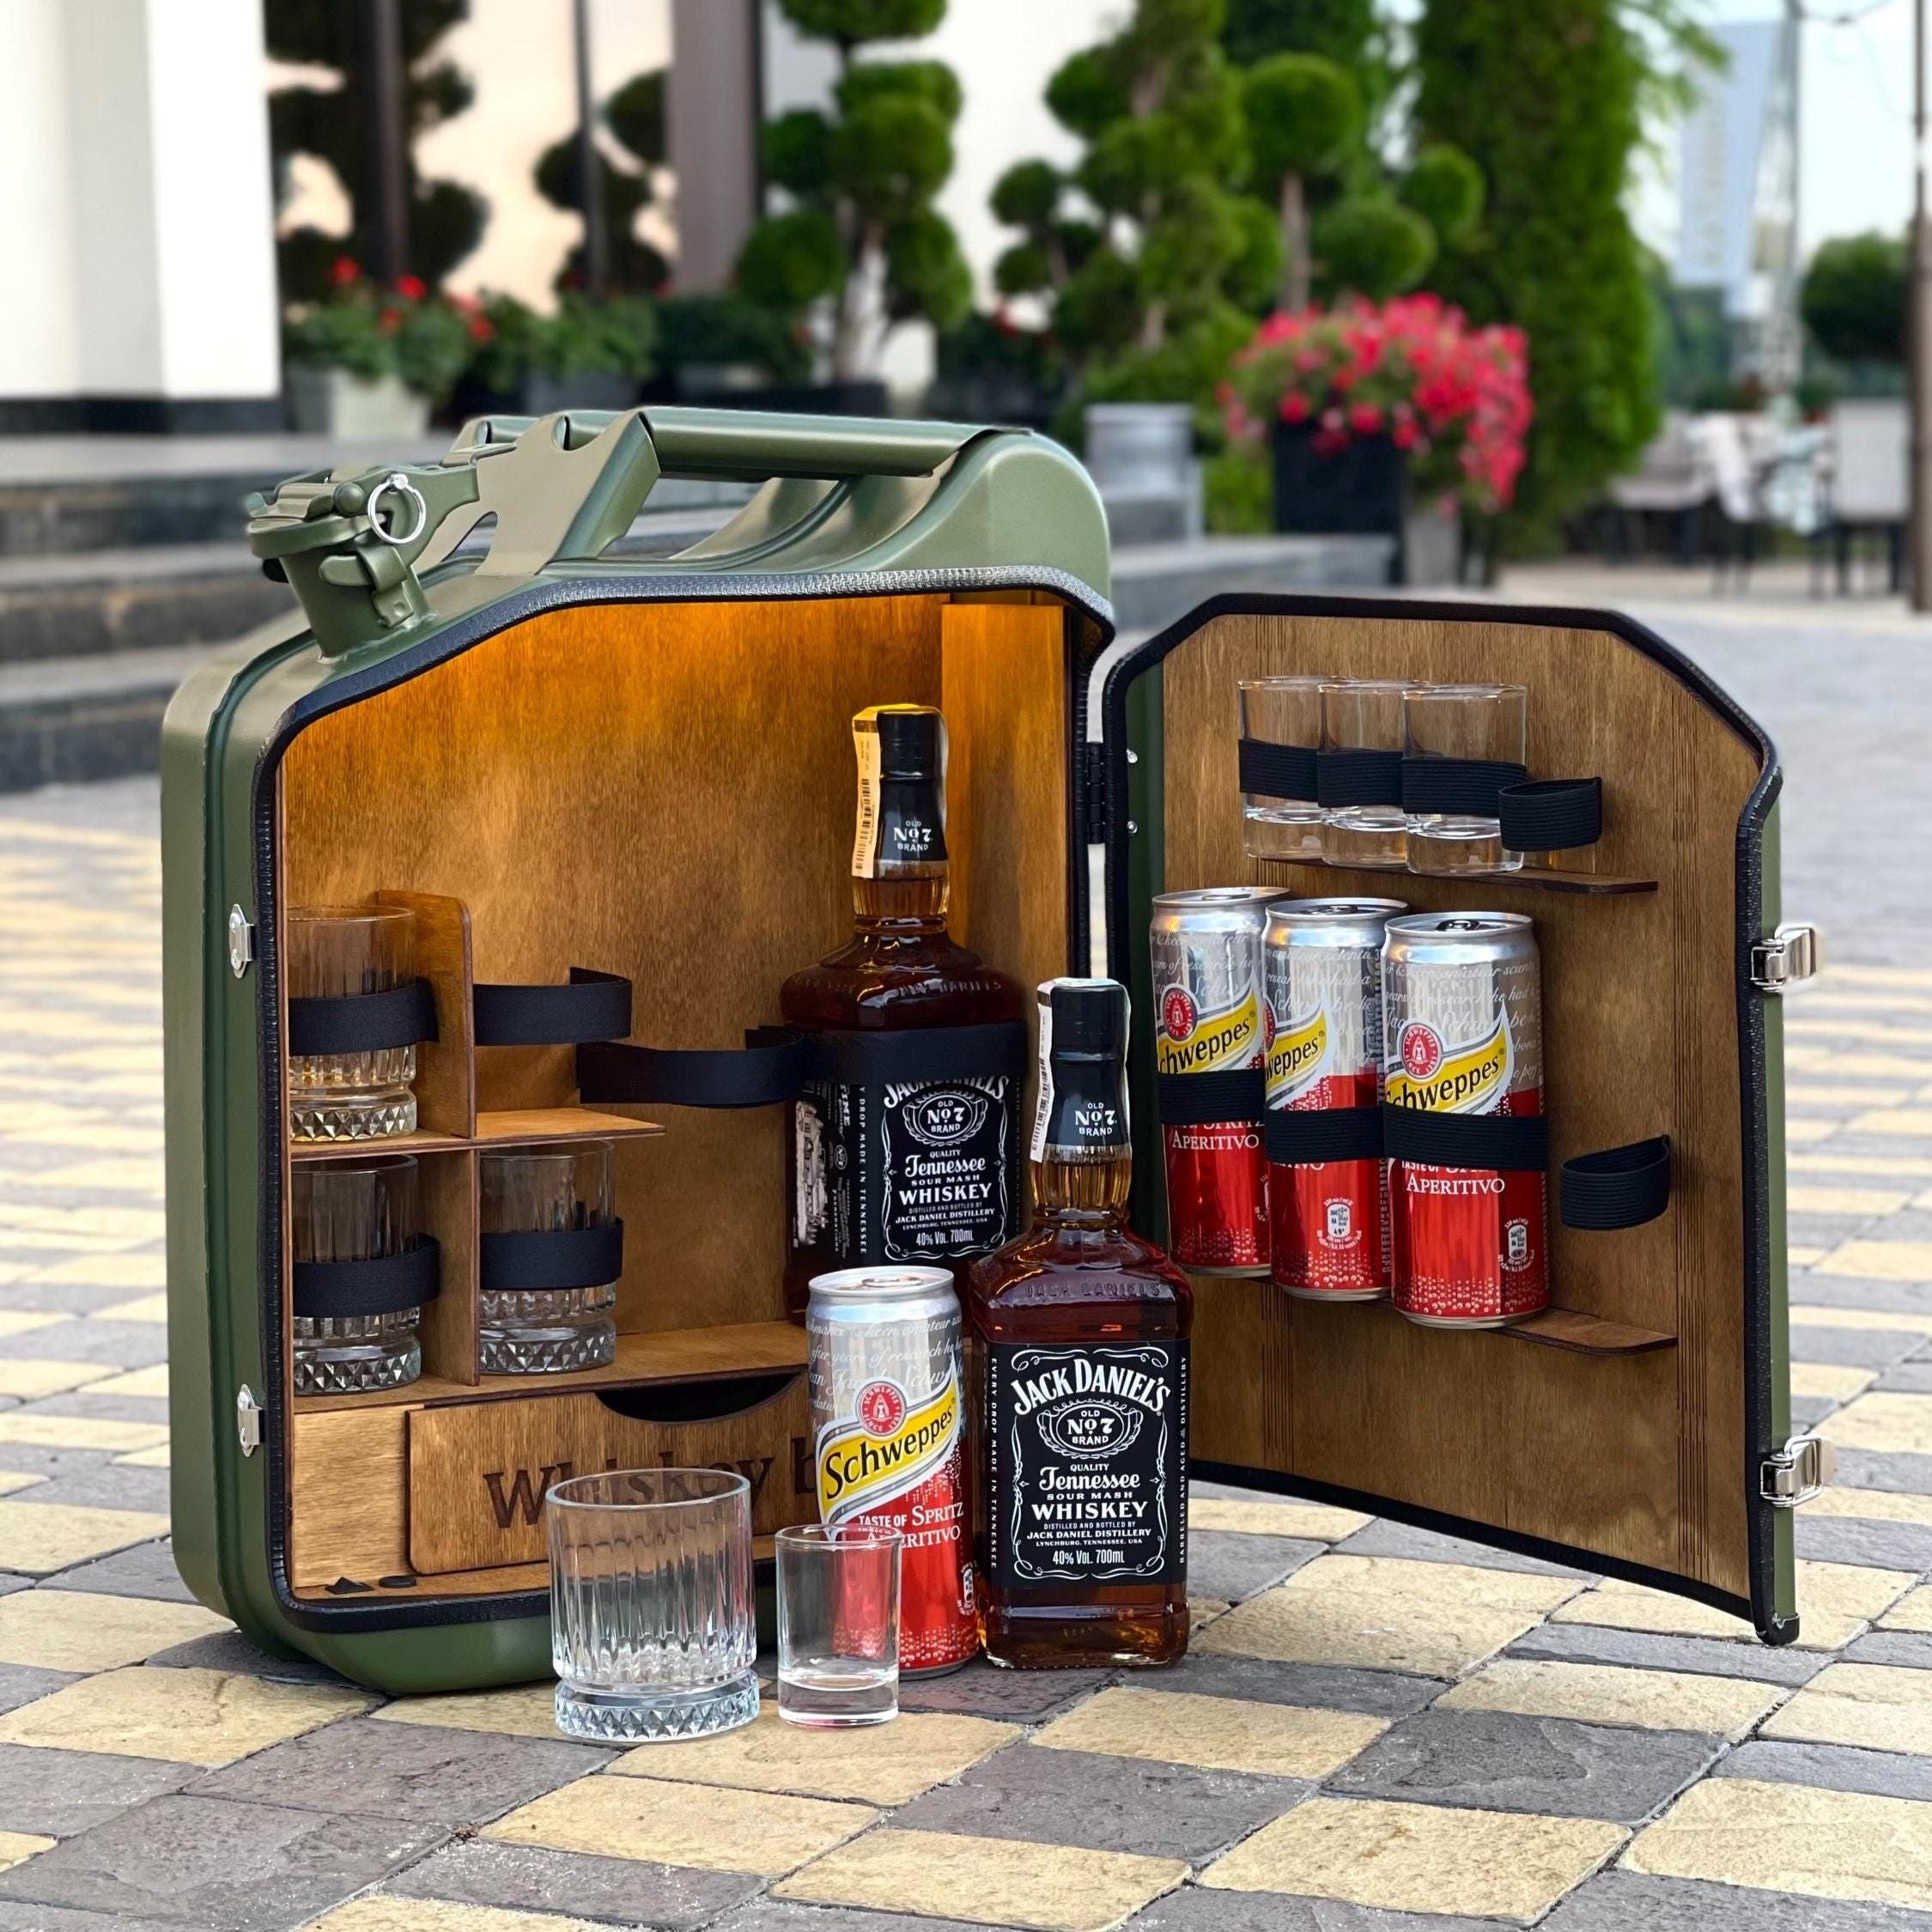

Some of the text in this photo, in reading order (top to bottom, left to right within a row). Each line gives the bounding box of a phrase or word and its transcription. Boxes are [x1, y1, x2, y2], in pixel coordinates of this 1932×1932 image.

[897, 842, 928, 852] BRAND
[938, 1099, 954, 1108] OLD
[931, 1123, 961, 1133] BRAND
[1078, 1127, 1113, 1137] BRAND
[1172, 1129, 1260, 1151] APERITIVO
[929, 1149, 962, 1159] QUALITY
[905, 1154, 987, 1177] Tennessee
[860, 1170, 866, 1182] IN
[911, 1174, 981, 1187] SOUR MASH
[1406, 1172, 1506, 1195] APERITIVO
[898, 1182, 993, 1206] WHISKEY
[895, 1207, 996, 1224] JACK DANIEL DISTILLERY
[908, 1204, 937, 1214] DISTILLED
[915, 1232, 934, 1246] 40%
[1011, 1358, 1171, 1416] JACK DANIEL'S
[1081, 1409, 1100, 1418] OLD
[1072, 1435, 1109, 1446] BRAND
[824, 1407, 953, 1499] Schweppes
[1070, 1462, 1109, 1472] QUALITY
[991, 1479, 997, 1492] IN
[1039, 1467, 1140, 1491] Tennessee
[1047, 1491, 1133, 1502] SOUR MASH
[858, 1502, 963, 1528] TASTE OF SPRITZ
[1031, 1501, 1148, 1521] WHISKEY
[1043, 1522, 1078, 1531] DISTILLED
[1027, 1528, 1151, 1540] JACK DANIEL DISTILLERY
[1053, 1550, 1073, 1565] 40%
